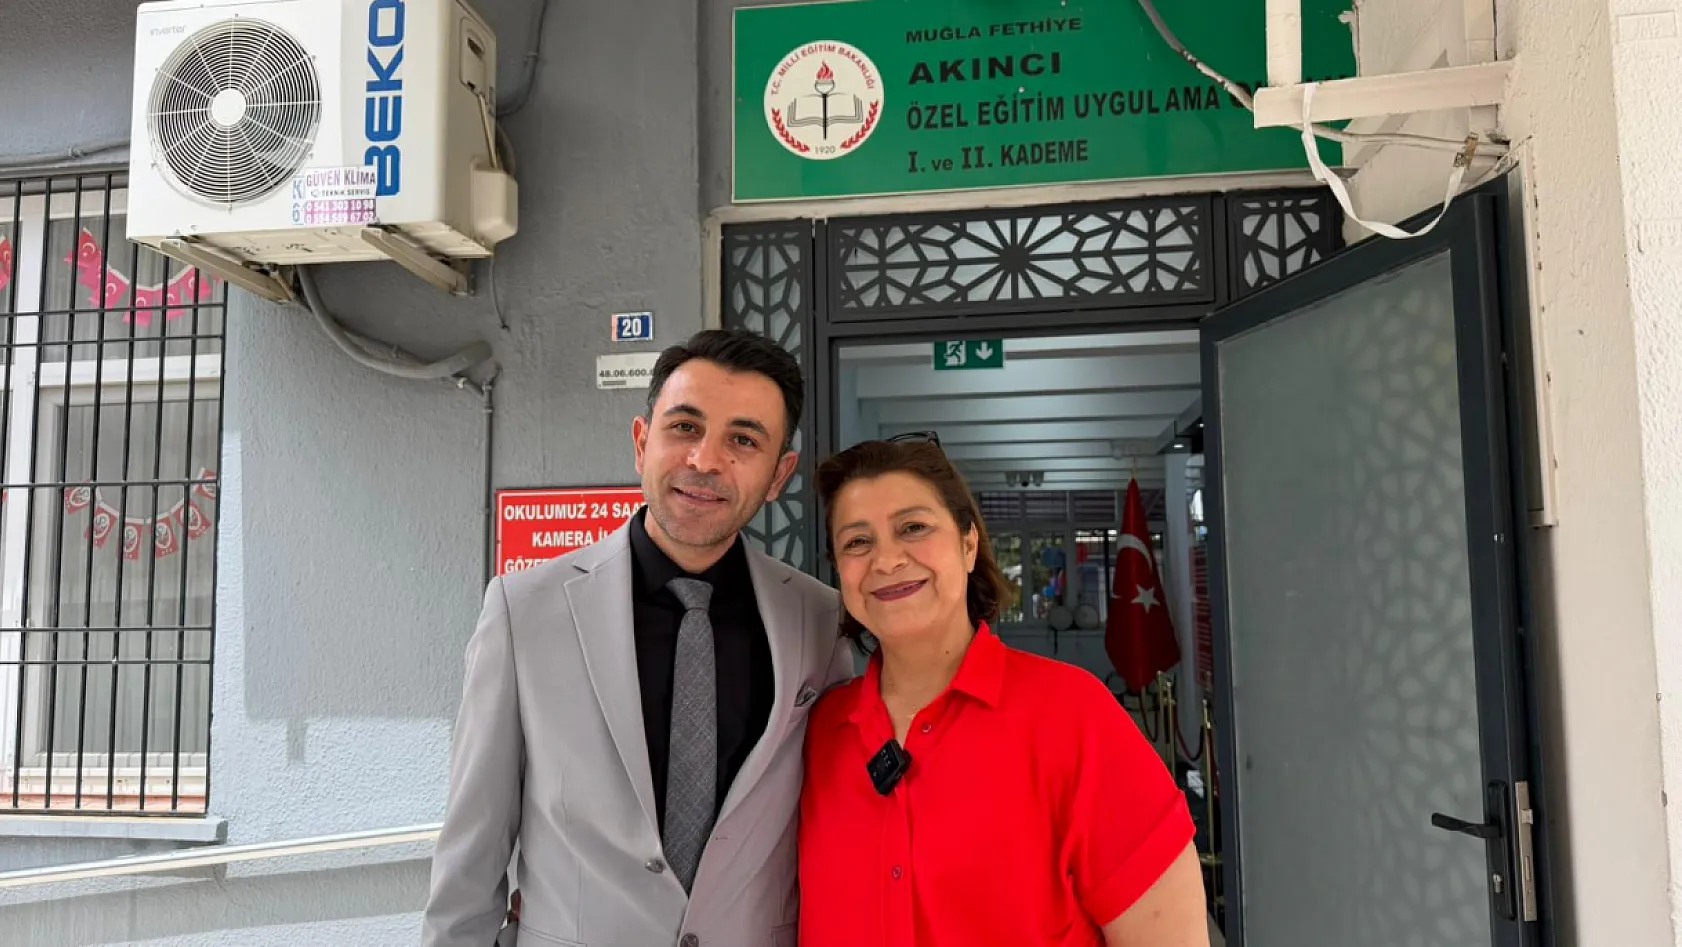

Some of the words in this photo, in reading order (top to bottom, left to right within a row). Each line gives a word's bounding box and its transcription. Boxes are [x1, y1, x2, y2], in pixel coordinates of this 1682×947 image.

[906, 25, 981, 44] MUĞLA
[988, 17, 1082, 37] FETHİYE
[908, 51, 1061, 86] AKINCI
[907, 101, 969, 131] ÖZEL
[978, 91, 1064, 127] EĞİTİM
[1074, 85, 1221, 119] UYGULAMA
[815, 145, 836, 155] 1920
[931, 158, 953, 172] ve
[1001, 140, 1088, 168] KADEME
[306, 169, 340, 187] GÜVEN
[622, 318, 642, 337] 20
[504, 503, 587, 521] OKULUMUZ
[590, 503, 608, 519] 24
[532, 530, 594, 548] KAMERA
